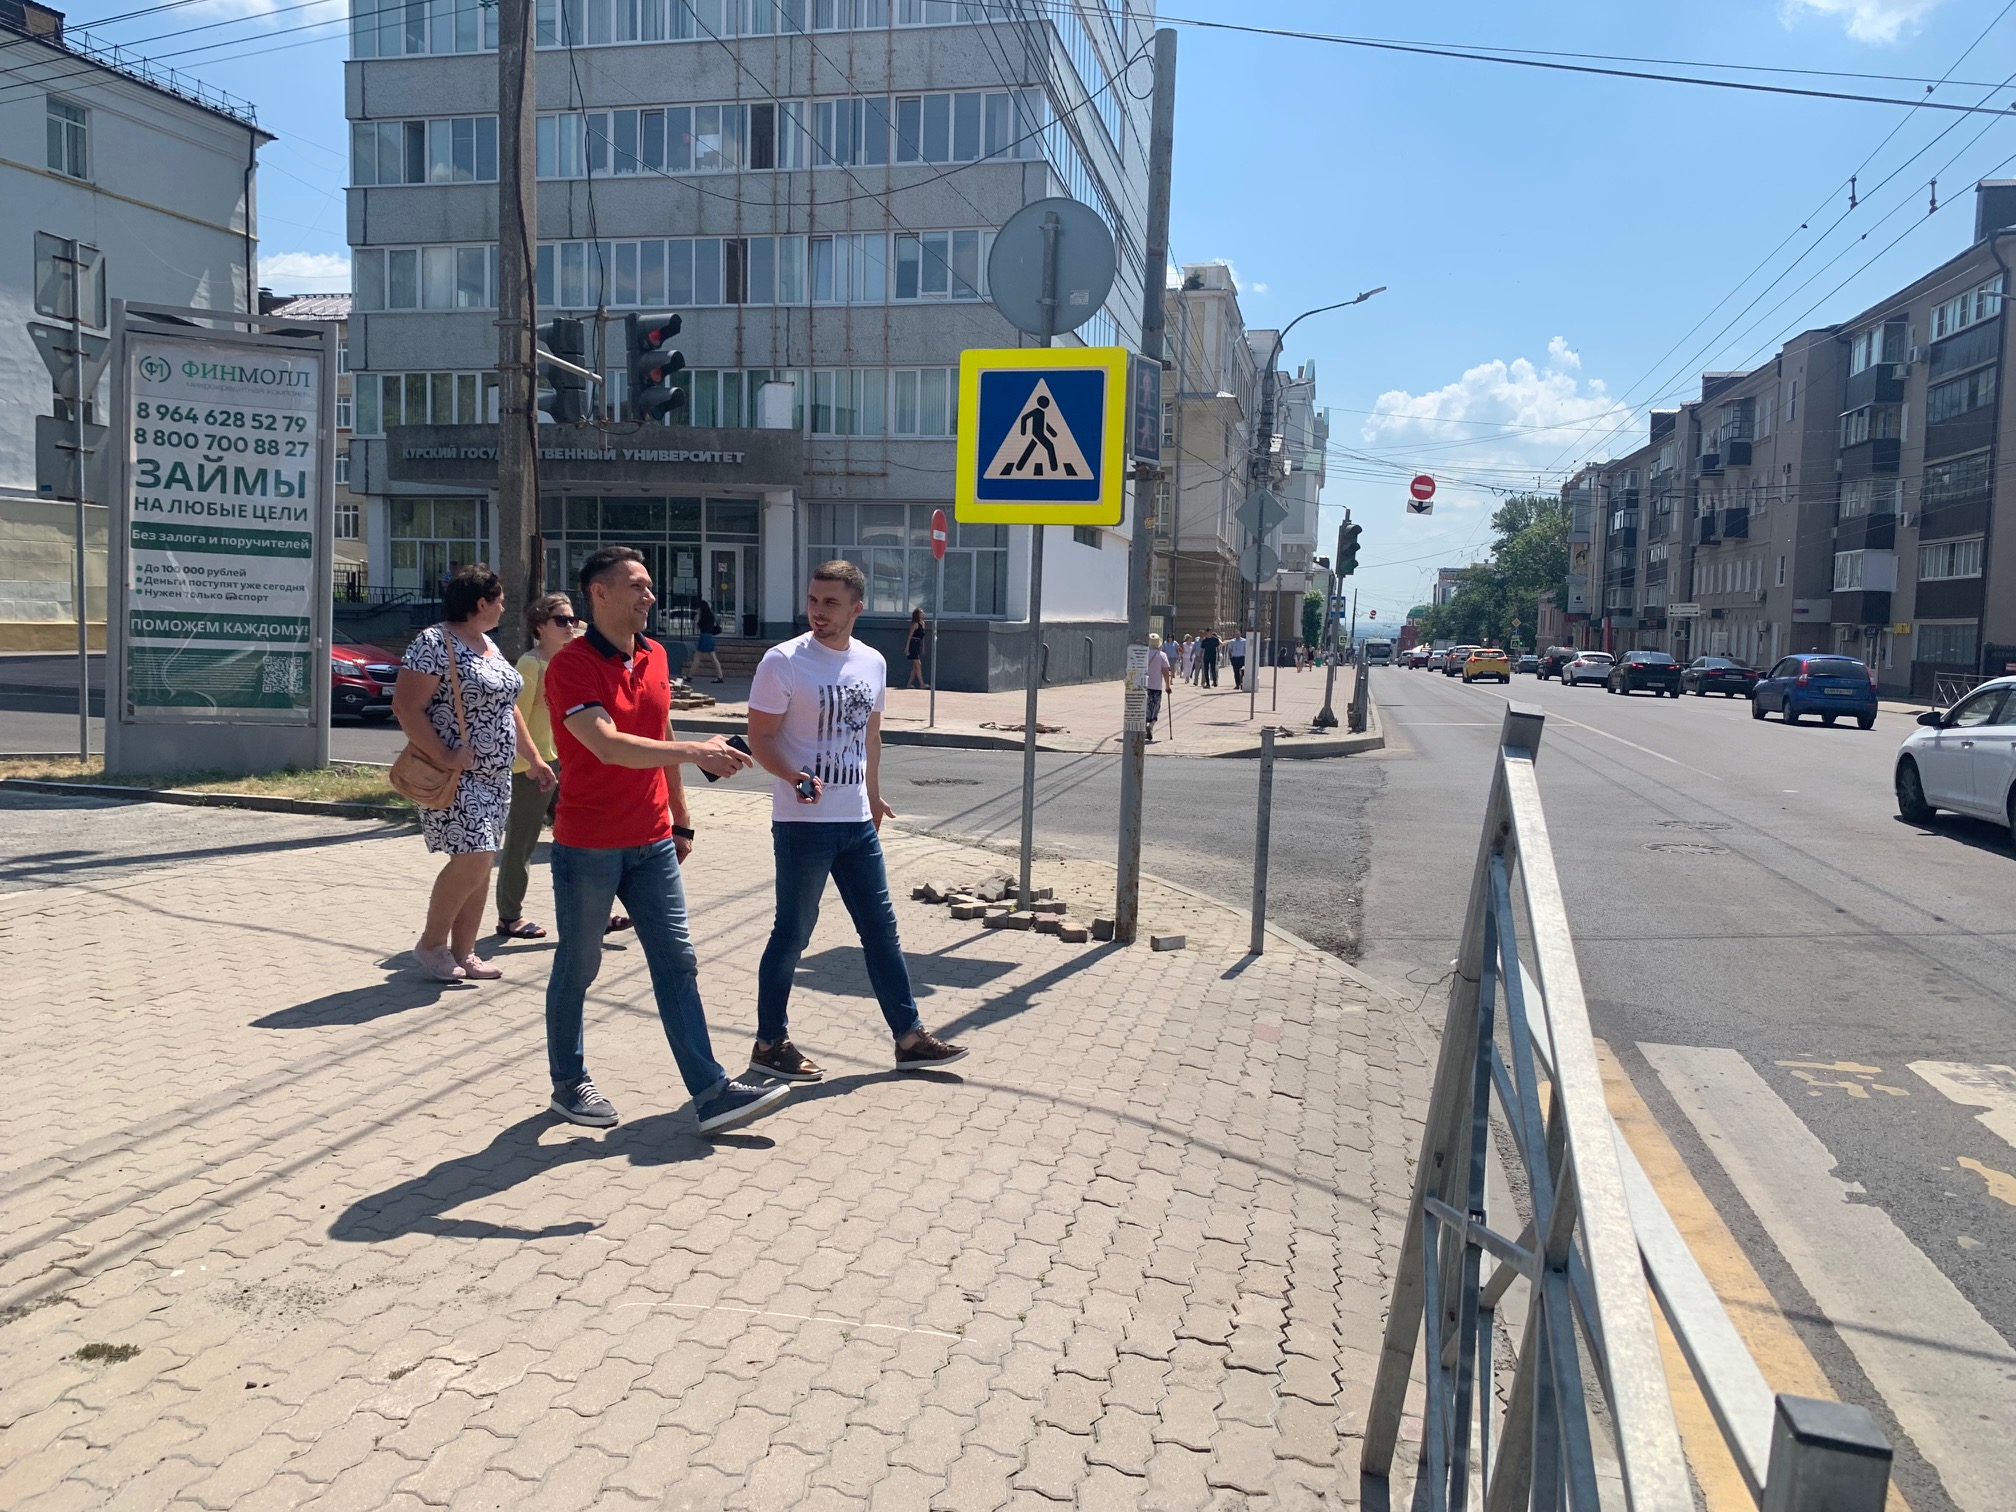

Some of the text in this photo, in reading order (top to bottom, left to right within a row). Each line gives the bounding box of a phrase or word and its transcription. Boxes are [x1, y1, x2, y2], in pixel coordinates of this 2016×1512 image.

[182, 360, 310, 388] ФИНМОЛЛ
[137, 402, 307, 433] 8 964 628 52 79
[134, 427, 309, 458] 8 800 700 88 27
[402, 444, 457, 459] КУРСКИЙ
[622, 449, 745, 463] УНИВЕРСИТЕТ
[135, 454, 306, 499] ЗАЙМЫ
[135, 496, 308, 523] НА ЛЮБЫЕ ЦЕЛИ
[132, 529, 310, 550] Без залога и поручителей
[144, 564, 247, 579] До 100 000 рублей
[144, 576, 305, 593] Деньги поступят уже сегодня
[144, 588, 182, 599] Нужен
[184, 591, 223, 600] только
[131, 618, 309, 637] ПОМОЖЕМ КАЖДОМУ!
